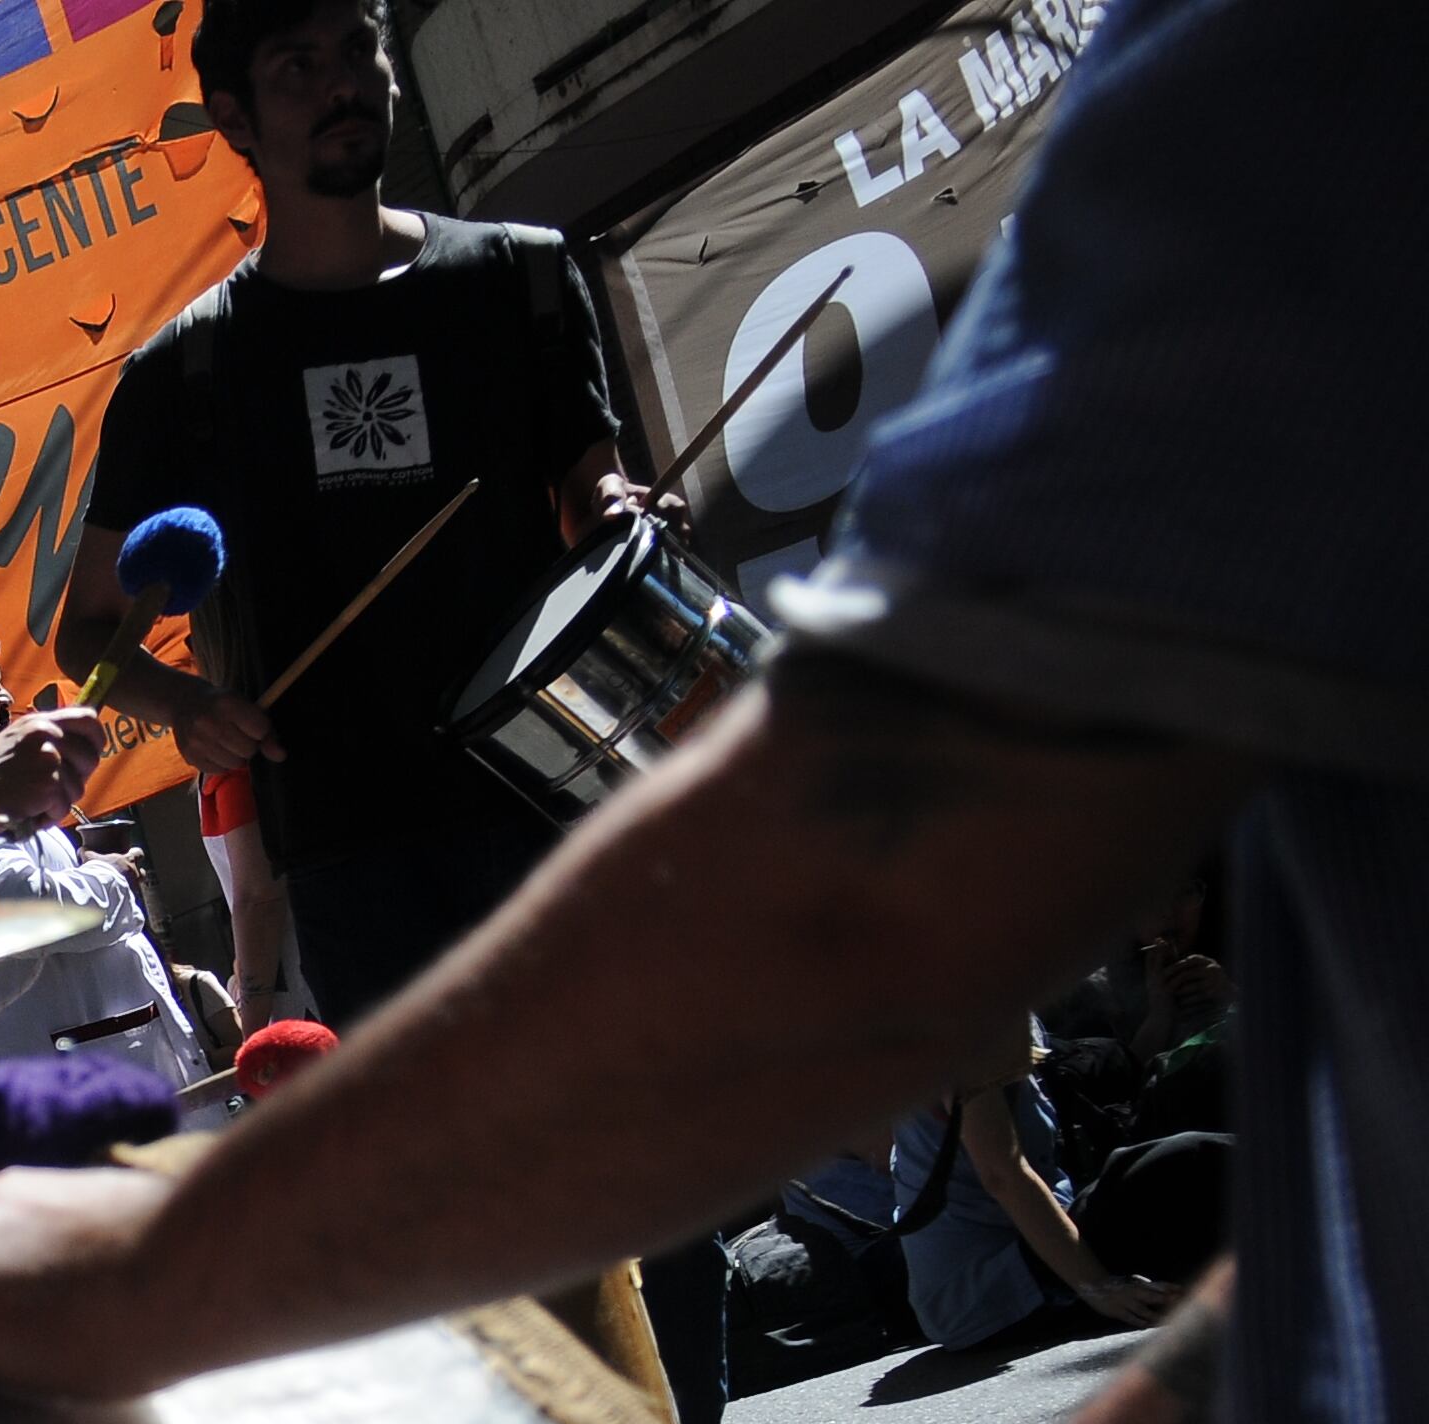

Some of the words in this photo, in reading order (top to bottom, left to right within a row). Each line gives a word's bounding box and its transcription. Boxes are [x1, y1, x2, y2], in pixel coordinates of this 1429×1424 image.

[833, 89, 961, 208] LA
[959, 0, 1108, 132] MAR
[390, 465, 434, 479] COTTON
